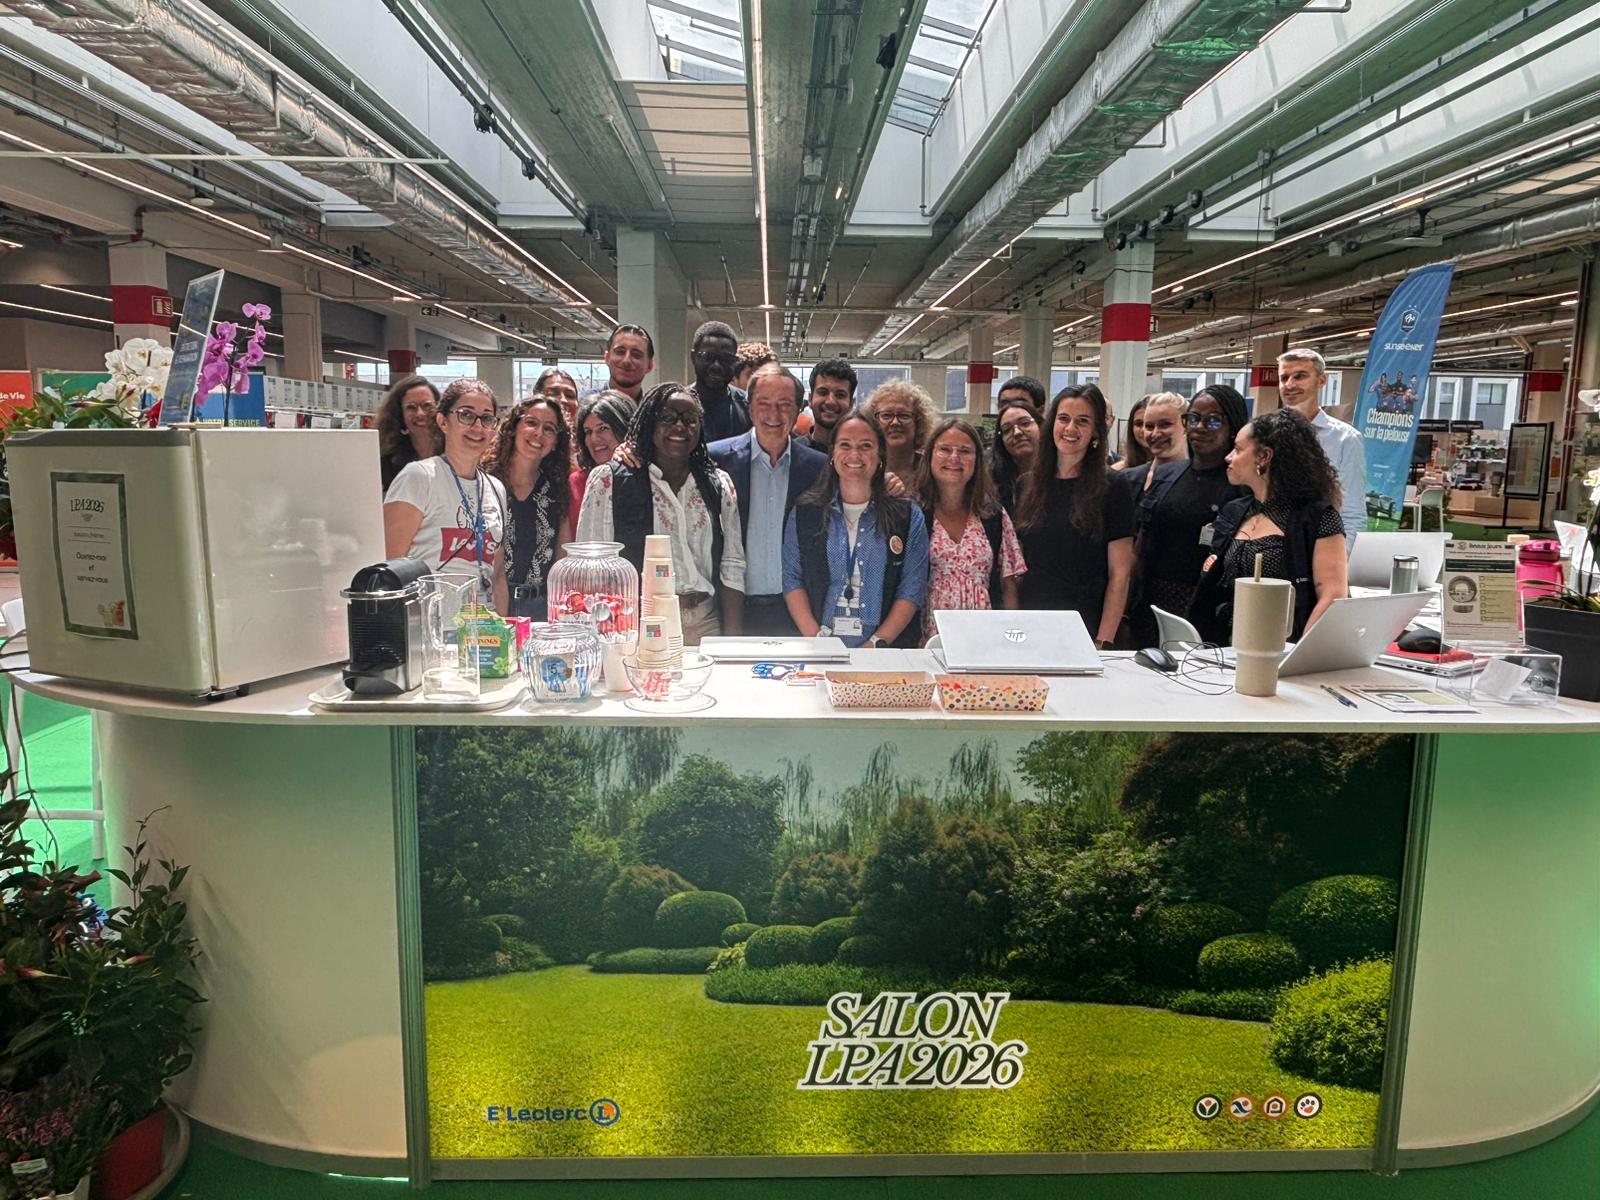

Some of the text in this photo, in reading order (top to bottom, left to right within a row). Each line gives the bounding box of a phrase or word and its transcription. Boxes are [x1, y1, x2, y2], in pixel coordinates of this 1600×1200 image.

[9, 392, 26, 400] Vie
[229, 419, 260, 427] SERVICE
[1366, 408, 1414, 428] Champions
[1364, 426, 1410, 442] sur la pelouse
[821, 993, 1009, 1040] SALON
[798, 1041, 1027, 1088] LPA2026
